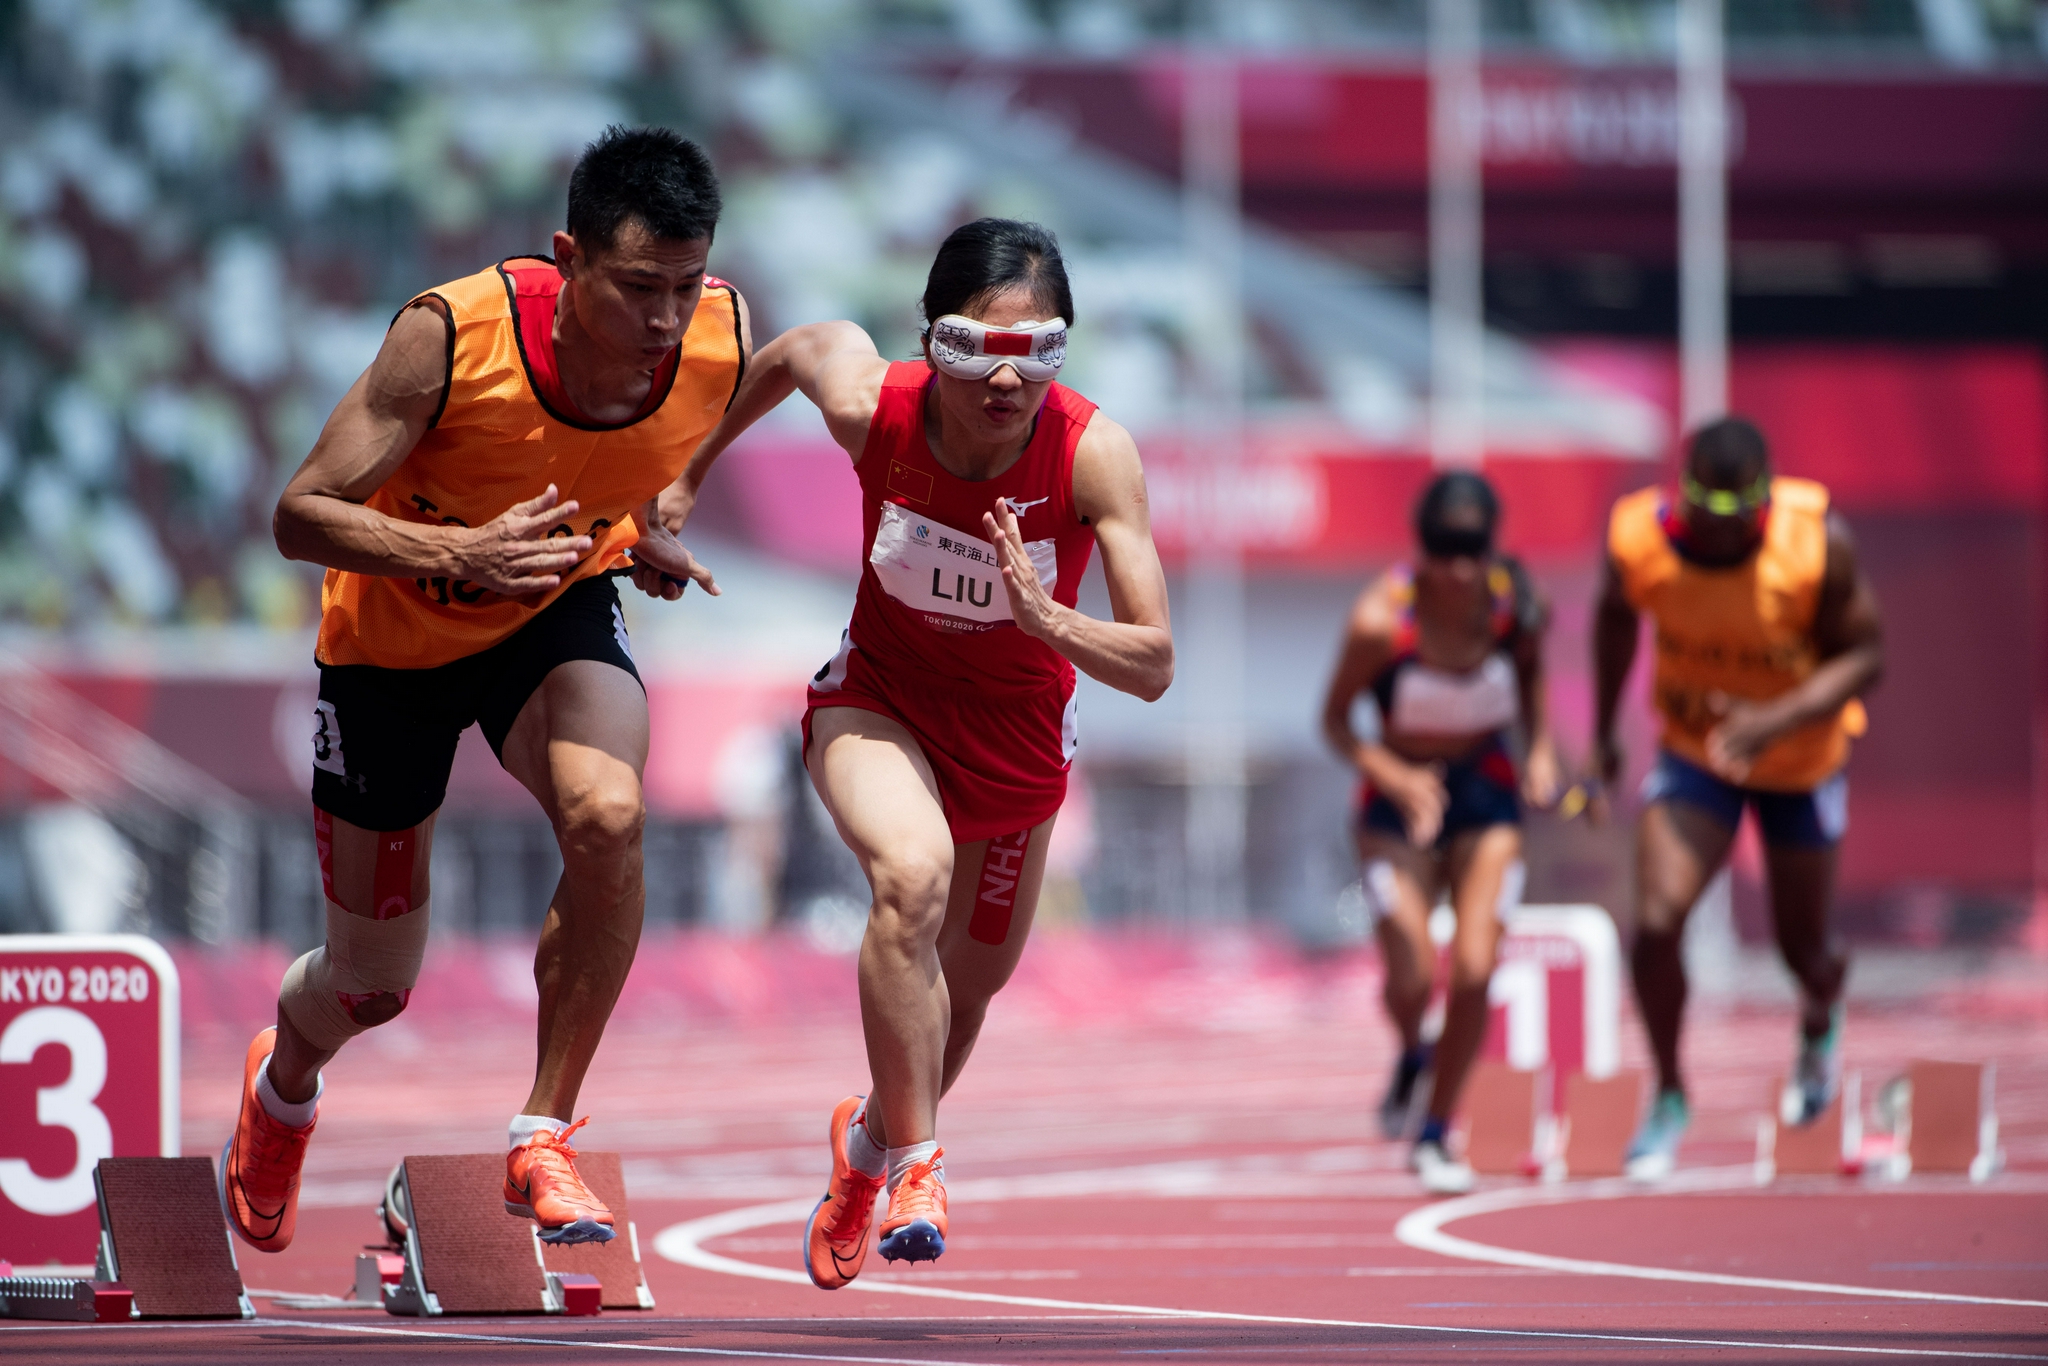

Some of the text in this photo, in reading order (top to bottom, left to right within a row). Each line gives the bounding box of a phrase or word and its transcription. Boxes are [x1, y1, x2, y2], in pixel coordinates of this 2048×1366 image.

[932, 567, 993, 608] LIU
[923, 614, 974, 631] TOKYO 2020
[390, 841, 404, 851] KT
[68, 966, 149, 1002] 2020
[0, 1005, 114, 1216] 3
